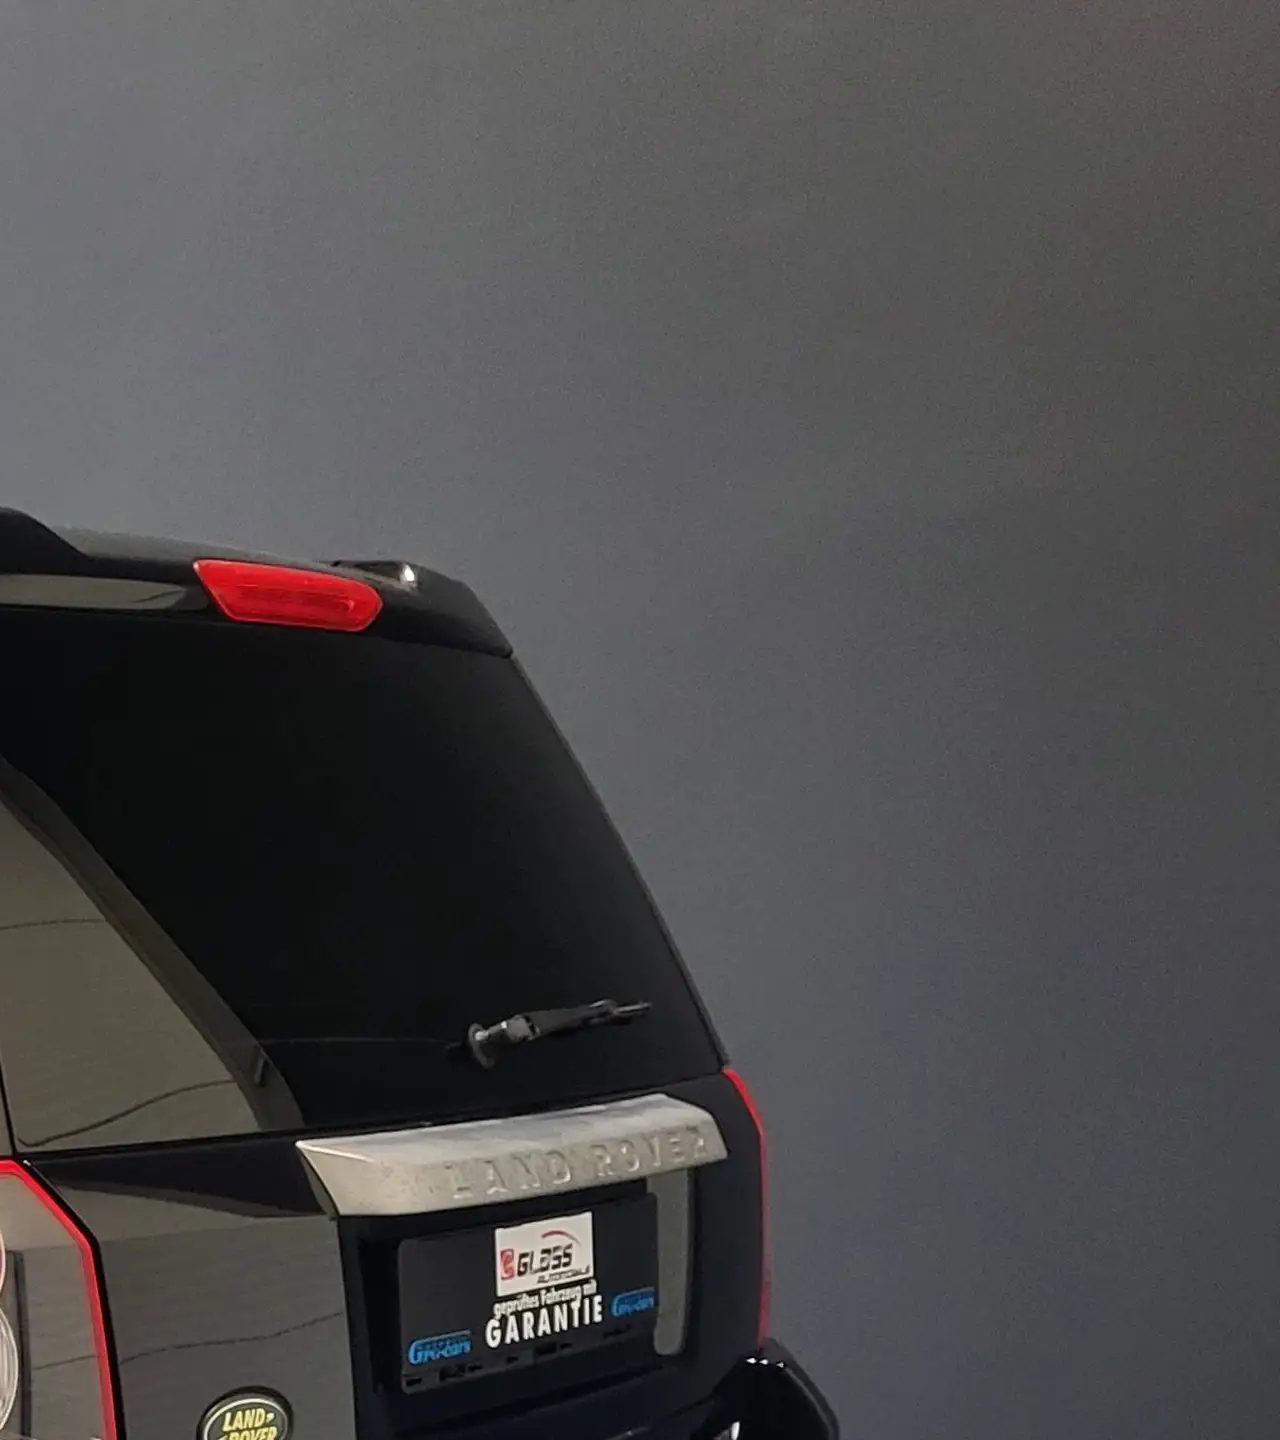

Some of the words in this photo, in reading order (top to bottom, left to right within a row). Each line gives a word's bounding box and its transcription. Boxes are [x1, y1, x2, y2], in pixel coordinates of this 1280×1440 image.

[444, 1148, 572, 1200] LAND
[590, 1124, 708, 1178] ROVER
[485, 1295, 603, 1349] GARANTIE
[221, 1408, 265, 1432] LAND
